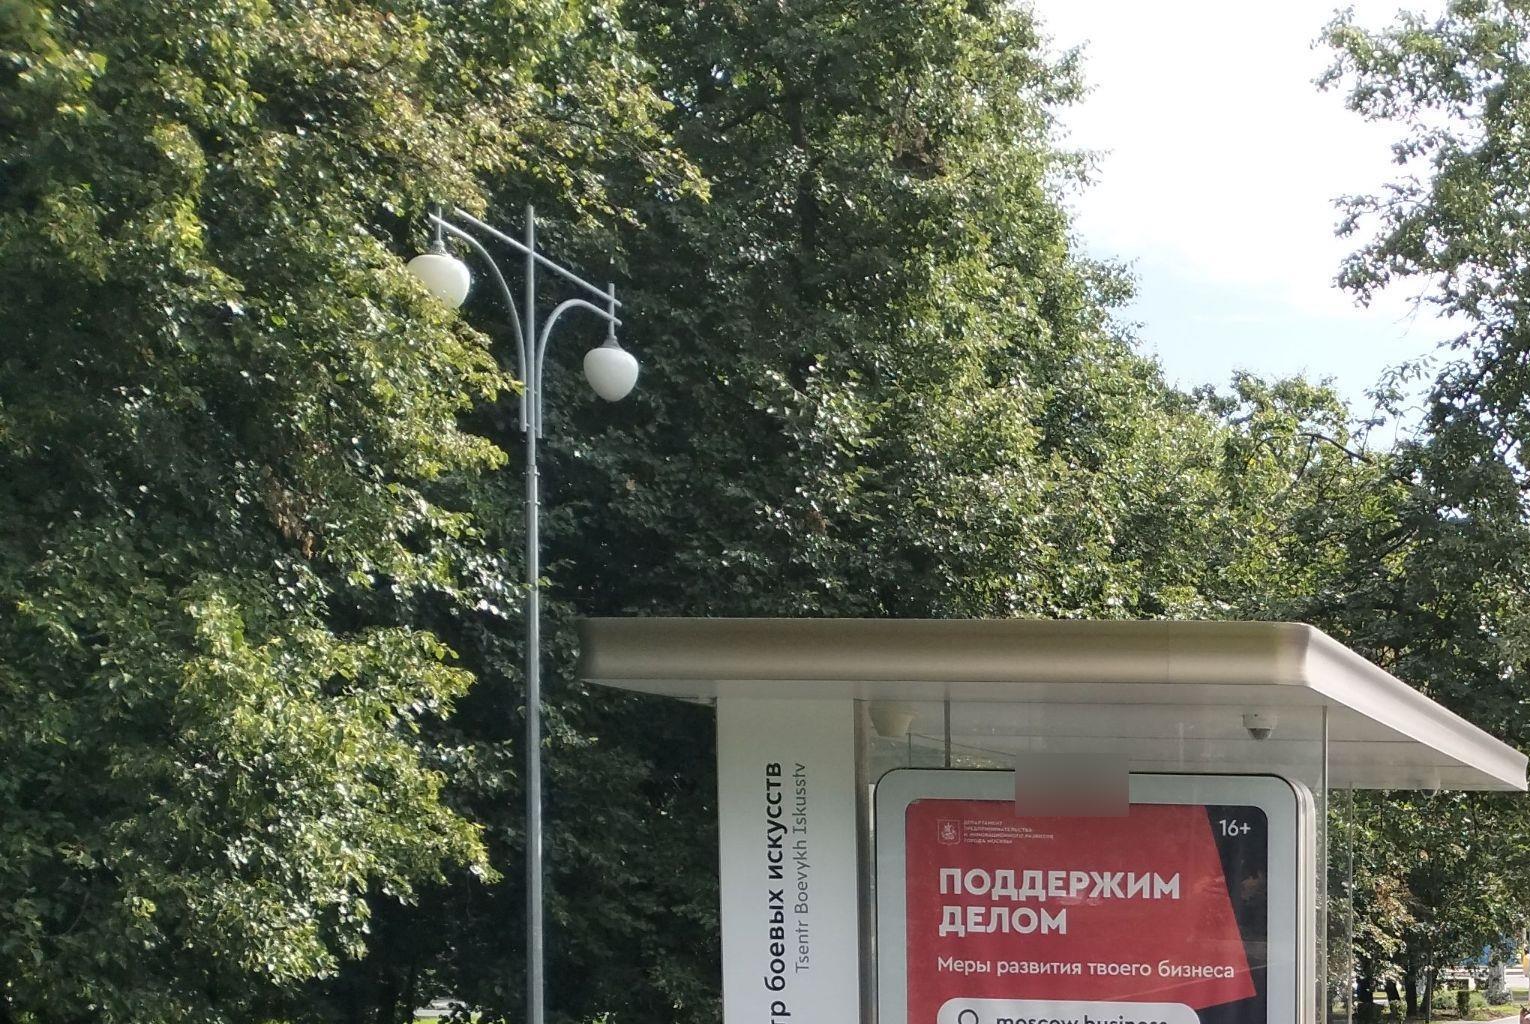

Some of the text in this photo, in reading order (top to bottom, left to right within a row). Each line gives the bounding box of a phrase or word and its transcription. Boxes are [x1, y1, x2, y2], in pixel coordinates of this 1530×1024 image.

[765, 761, 788, 881] искусств
[1219, 818, 1252, 838] 16+
[791, 762, 811, 975] Tsentr Boevykh Iskusstv
[938, 867, 1181, 901] ПОДДЕРЖИМ
[938, 905, 1068, 938] ДЕЛОМ
[764, 888, 785, 992] боевых
[937, 956, 1235, 979] Меры развития твоего бизнеса
